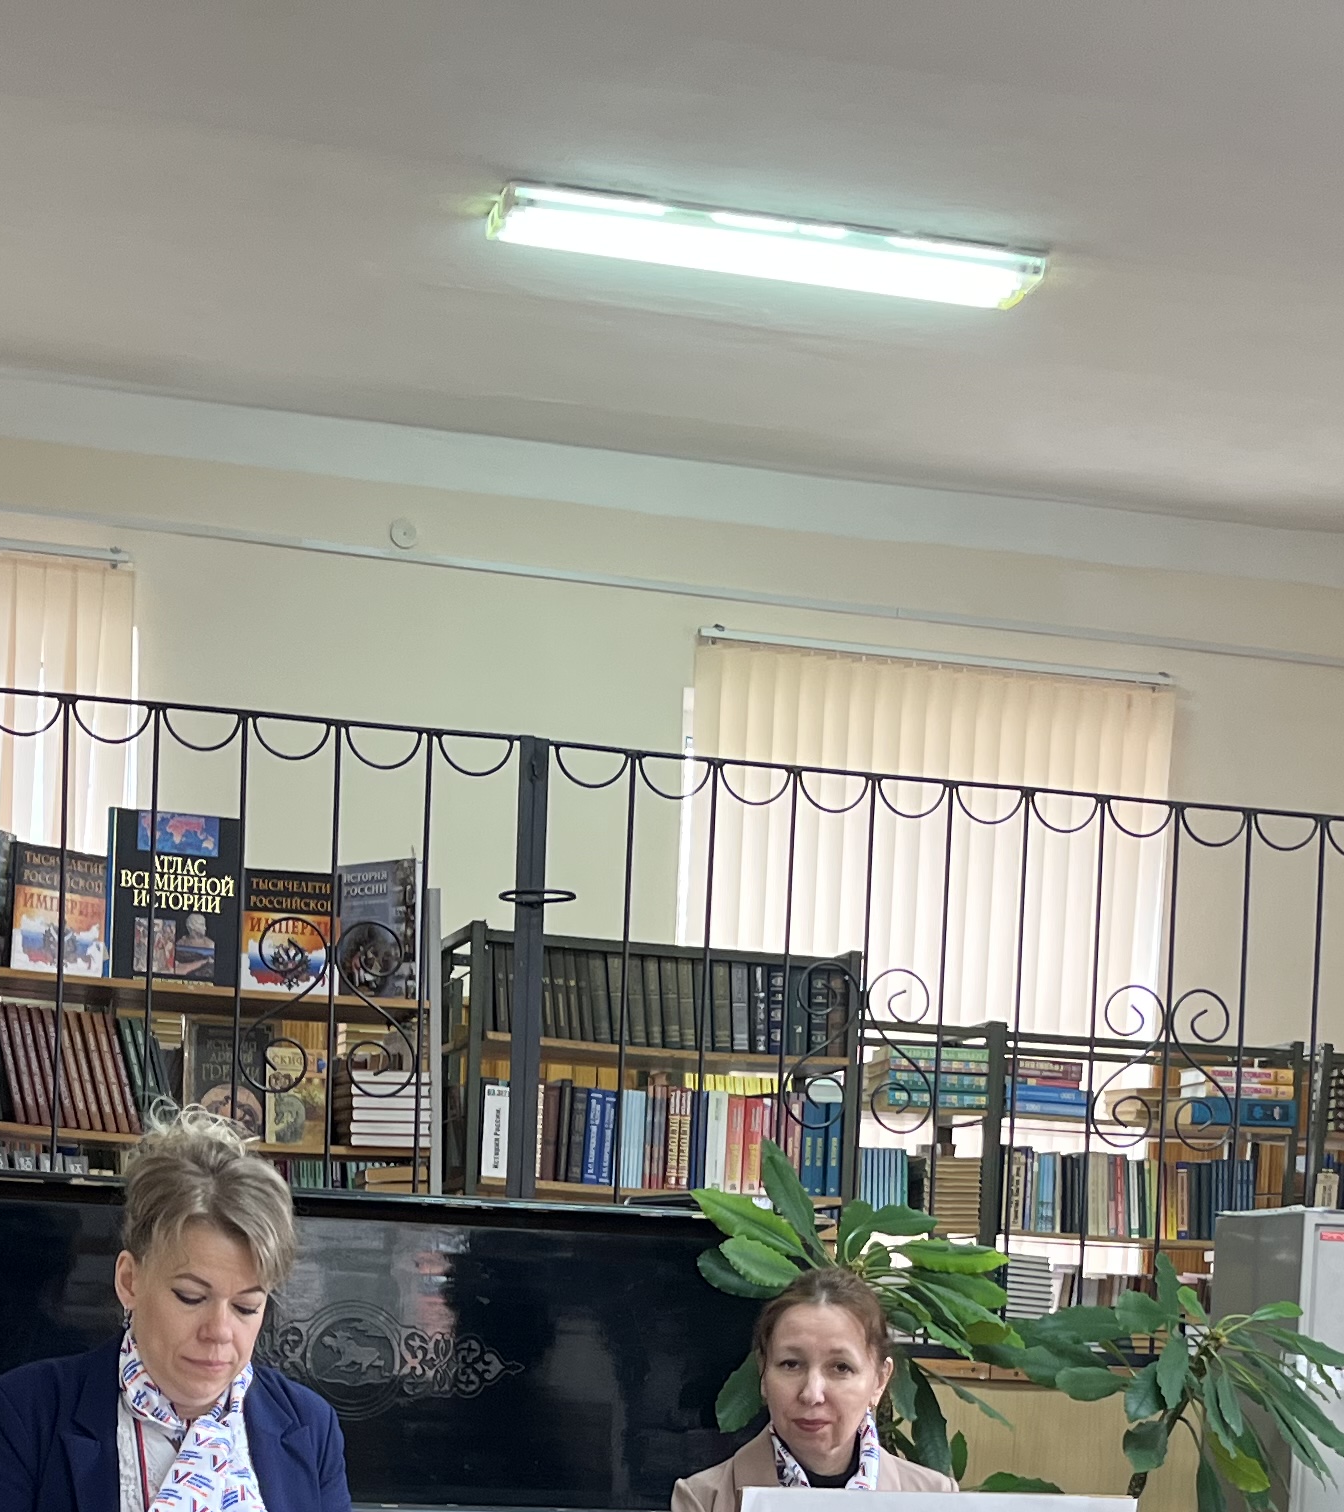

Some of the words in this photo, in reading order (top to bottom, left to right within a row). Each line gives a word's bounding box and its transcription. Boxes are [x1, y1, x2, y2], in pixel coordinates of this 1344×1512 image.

[24, 850, 105, 876] ТЫСЯЛЕТИЕ
[250, 877, 331, 895] ТЫСЯЧЕЛЕТИ
[23, 892, 102, 917] ИМПРИИ
